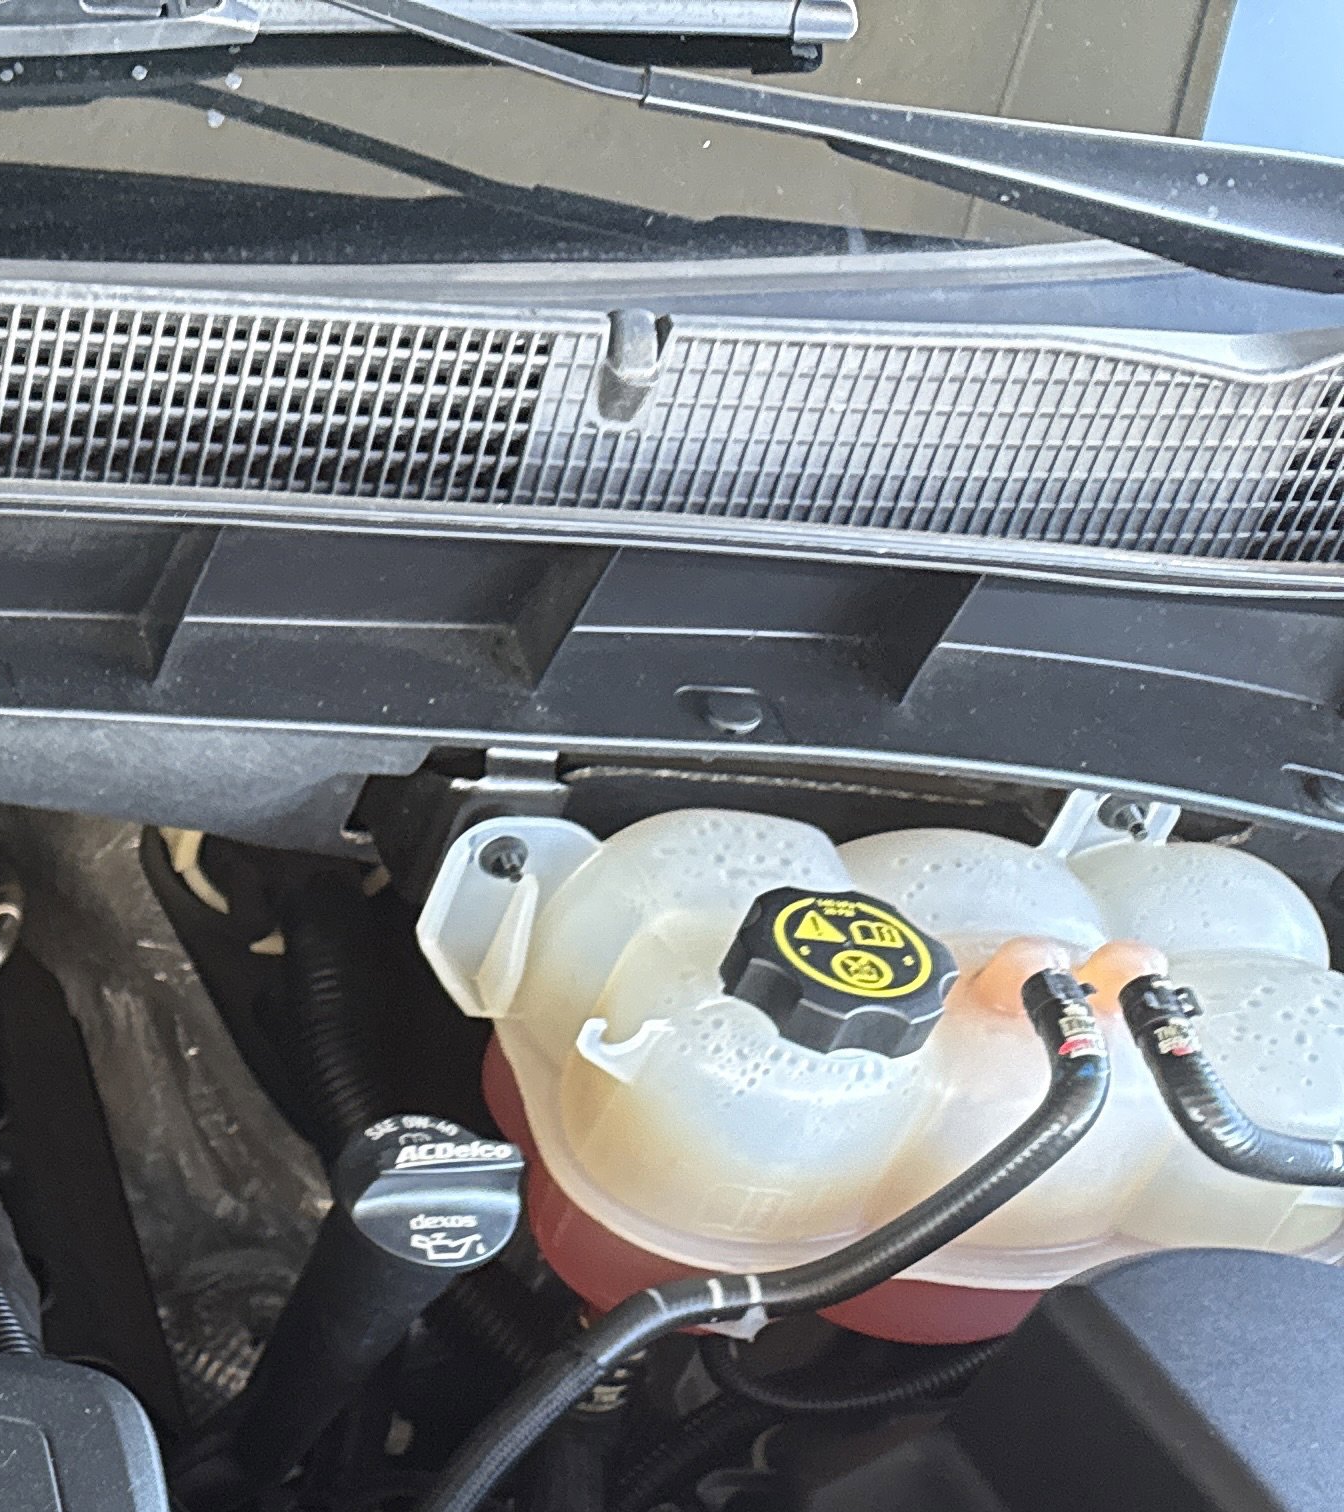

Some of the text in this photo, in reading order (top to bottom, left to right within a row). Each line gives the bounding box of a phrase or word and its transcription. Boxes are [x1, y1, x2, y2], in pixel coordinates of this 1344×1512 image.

[364, 1118, 399, 1141] SAE
[395, 1141, 512, 1164] ACDelco
[410, 1213, 478, 1230] dexos
